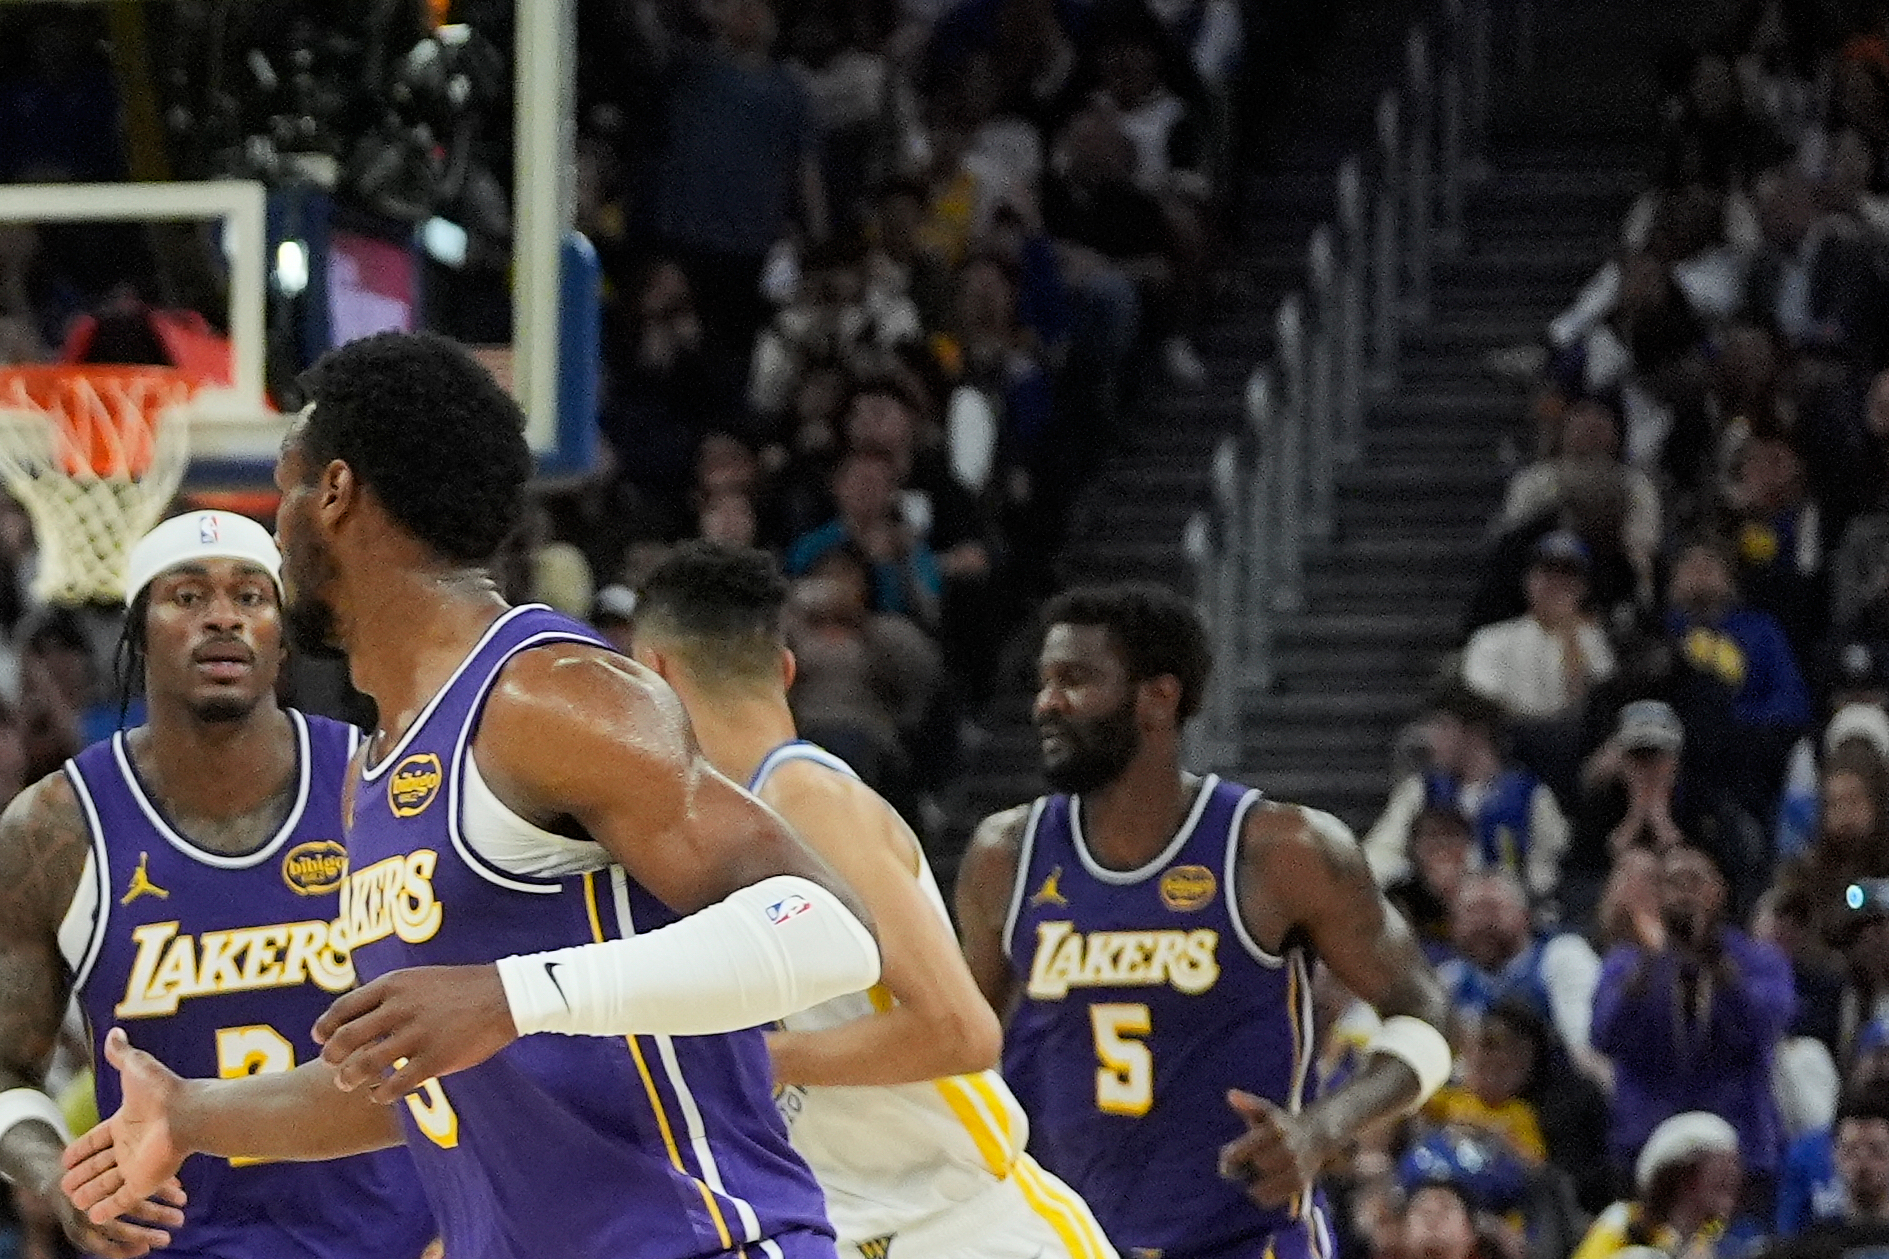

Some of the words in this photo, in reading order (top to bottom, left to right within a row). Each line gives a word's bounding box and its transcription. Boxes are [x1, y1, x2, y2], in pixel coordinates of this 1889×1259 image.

[340, 848, 443, 944] KERS
[115, 919, 357, 1018] LAKERS
[1027, 920, 1220, 1000] LAKERS
[1089, 1002, 1154, 1117] 5
